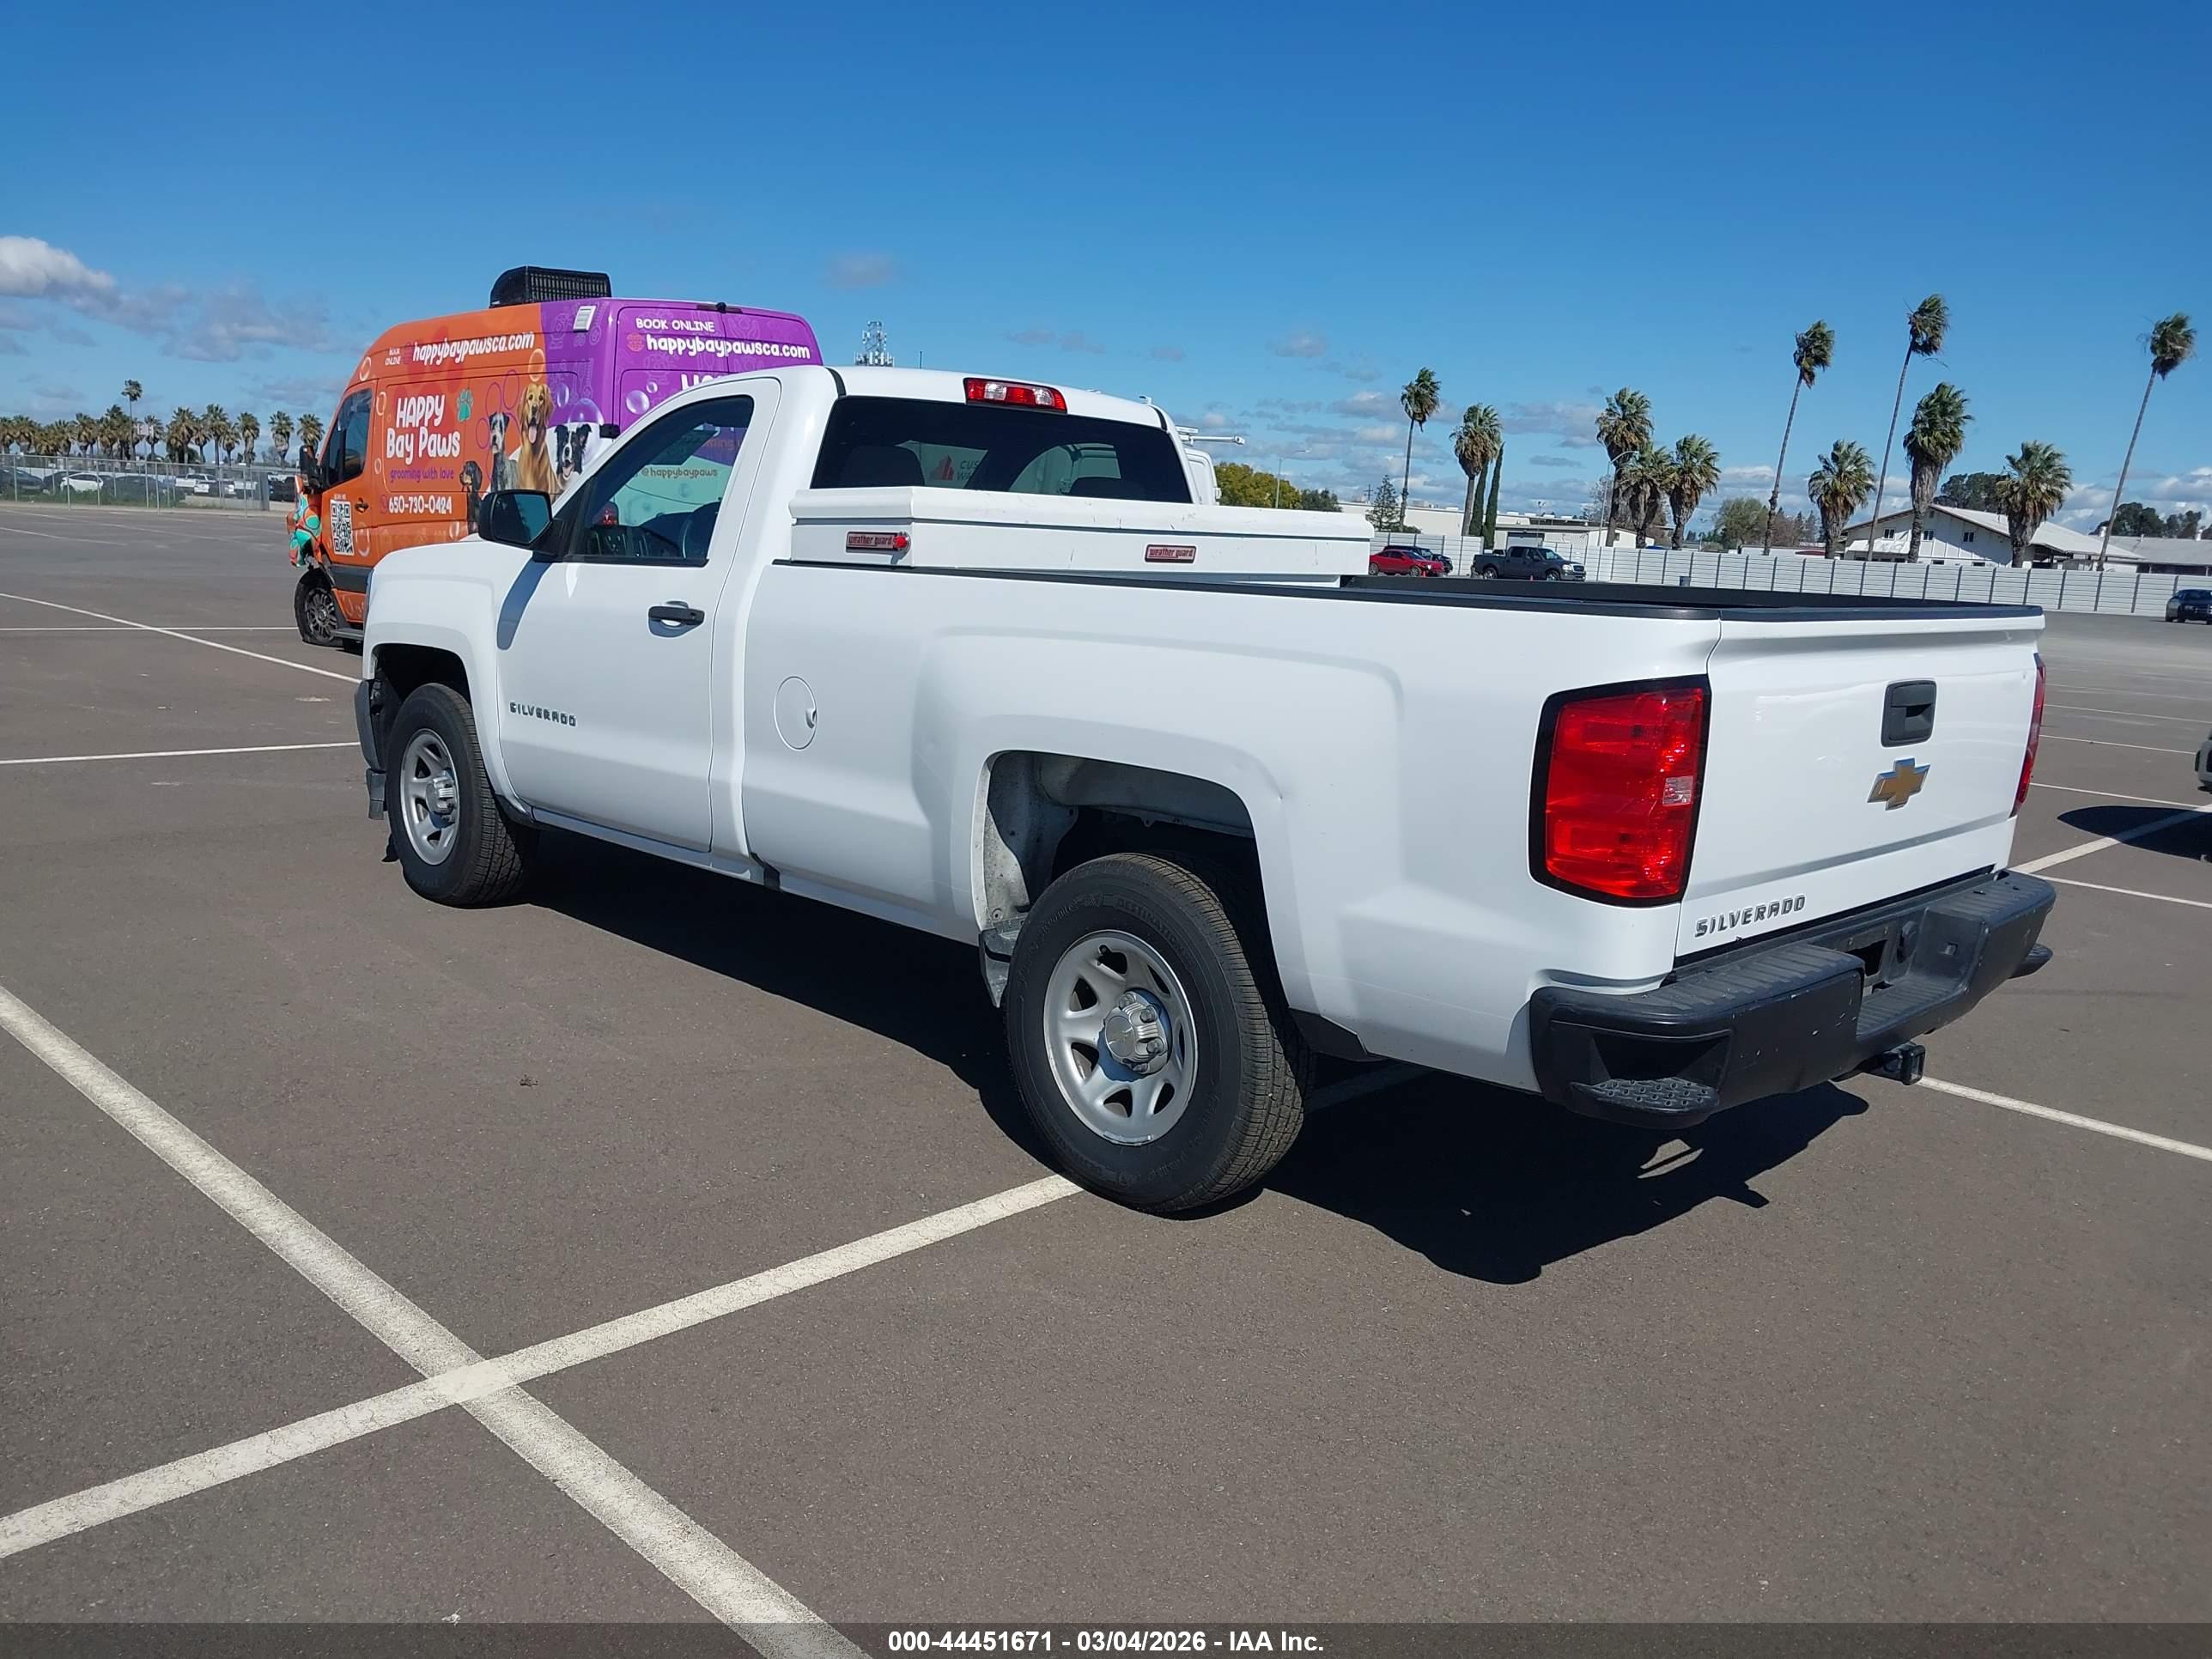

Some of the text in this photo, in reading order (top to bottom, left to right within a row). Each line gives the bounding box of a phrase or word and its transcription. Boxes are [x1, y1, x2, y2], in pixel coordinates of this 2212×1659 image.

[635, 318, 715, 332] BOOK ONLINE
[413, 331, 535, 367] happybaypawsca.com
[646, 333, 811, 359] happybaypawsca.com
[396, 395, 445, 428] HAPPY
[386, 426, 461, 465] Bay Paws
[390, 466, 454, 483] grooming with love
[389, 495, 453, 514] 650-730-0424
[848, 535, 873, 544] weather
[509, 702, 576, 726] SILVERADO
[1695, 895, 1806, 938] SILVERADO
